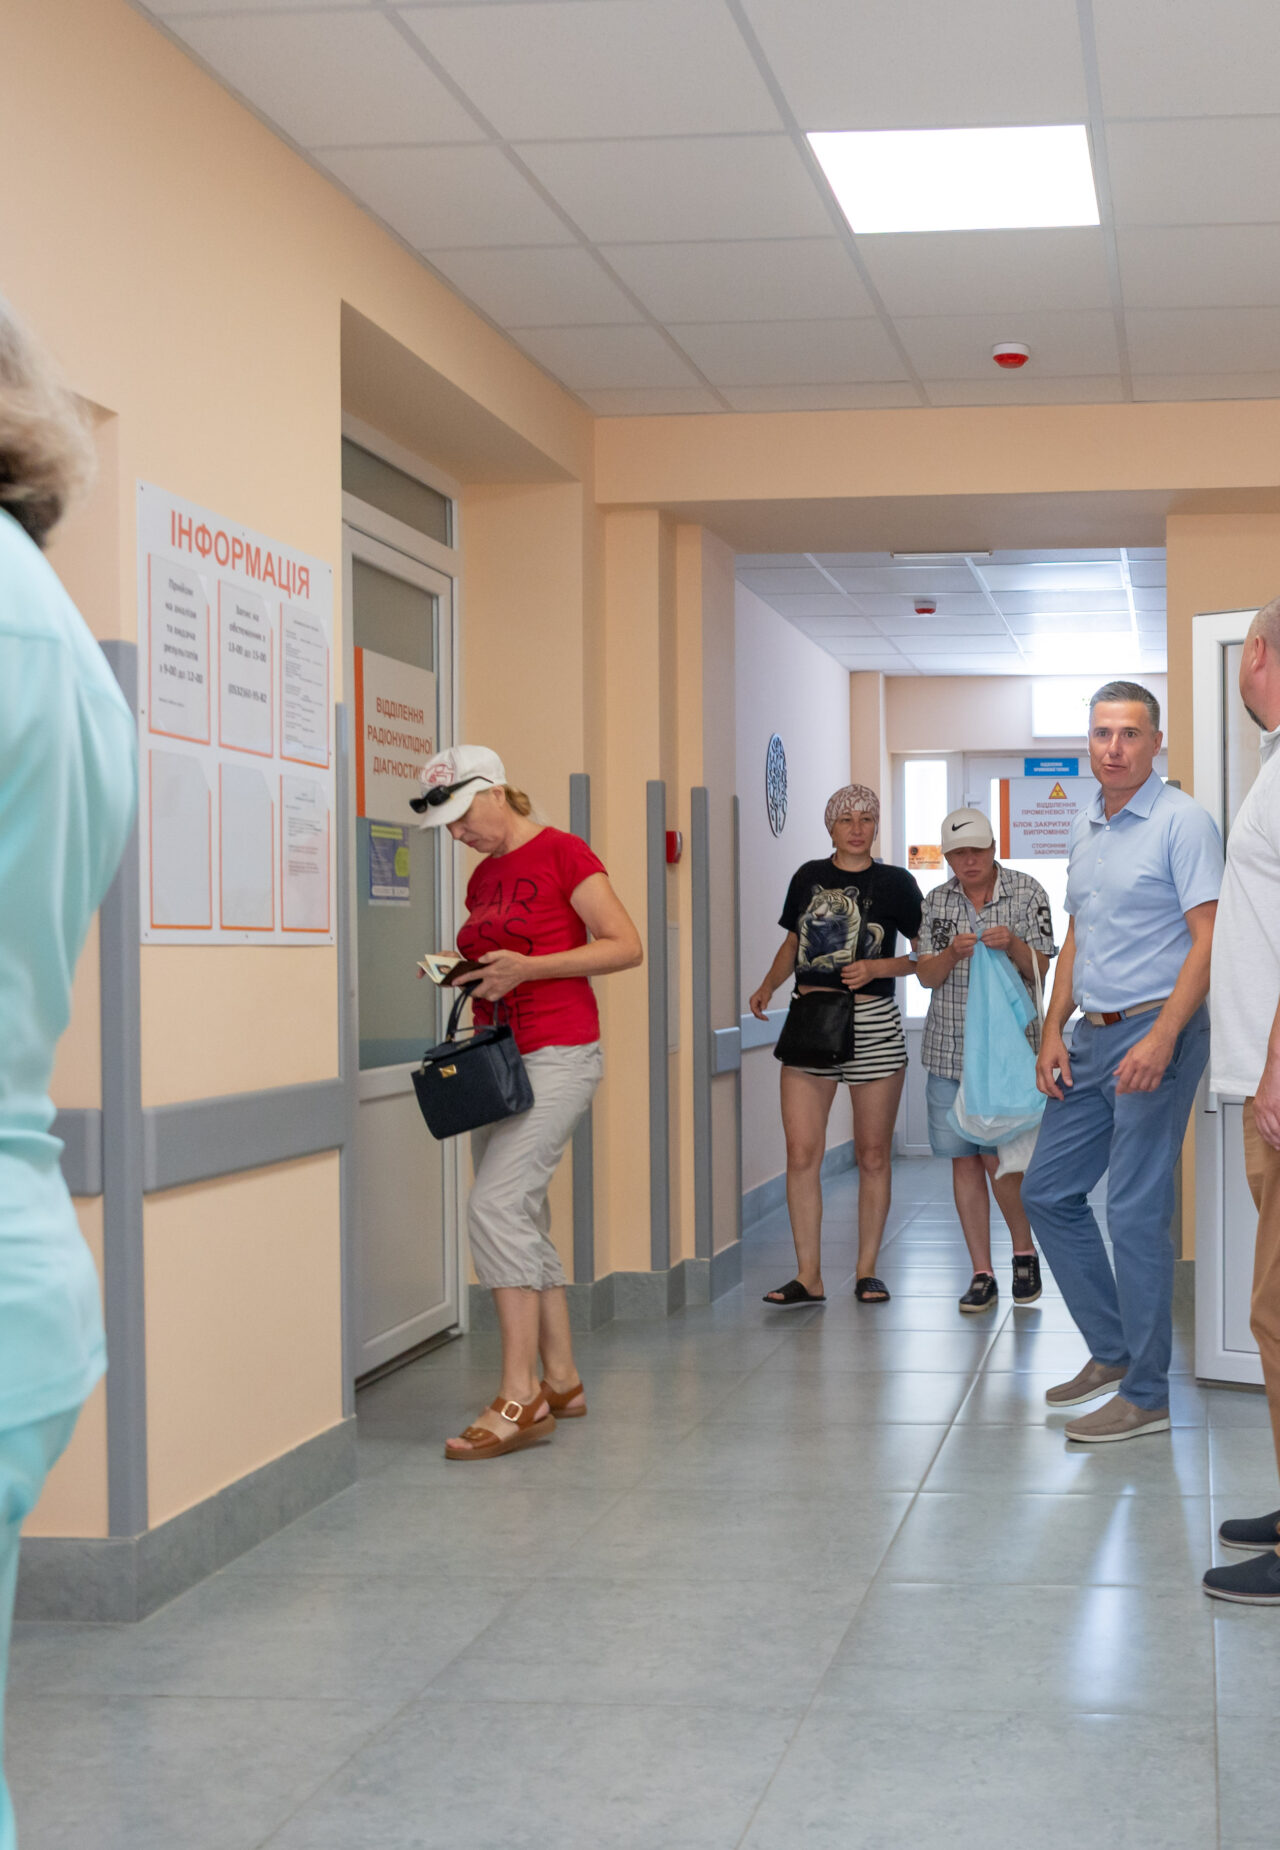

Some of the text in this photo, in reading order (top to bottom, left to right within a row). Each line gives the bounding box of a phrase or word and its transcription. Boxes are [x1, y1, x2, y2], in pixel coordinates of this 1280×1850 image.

[170, 509, 311, 600] ІНФОРМАЦІЯ
[376, 697, 424, 725] ВІДДІЛЕННЯ
[367, 724, 433, 756] РАДІОНУКЛІДНОЇ
[1067, 808, 1079, 816] ТЕР
